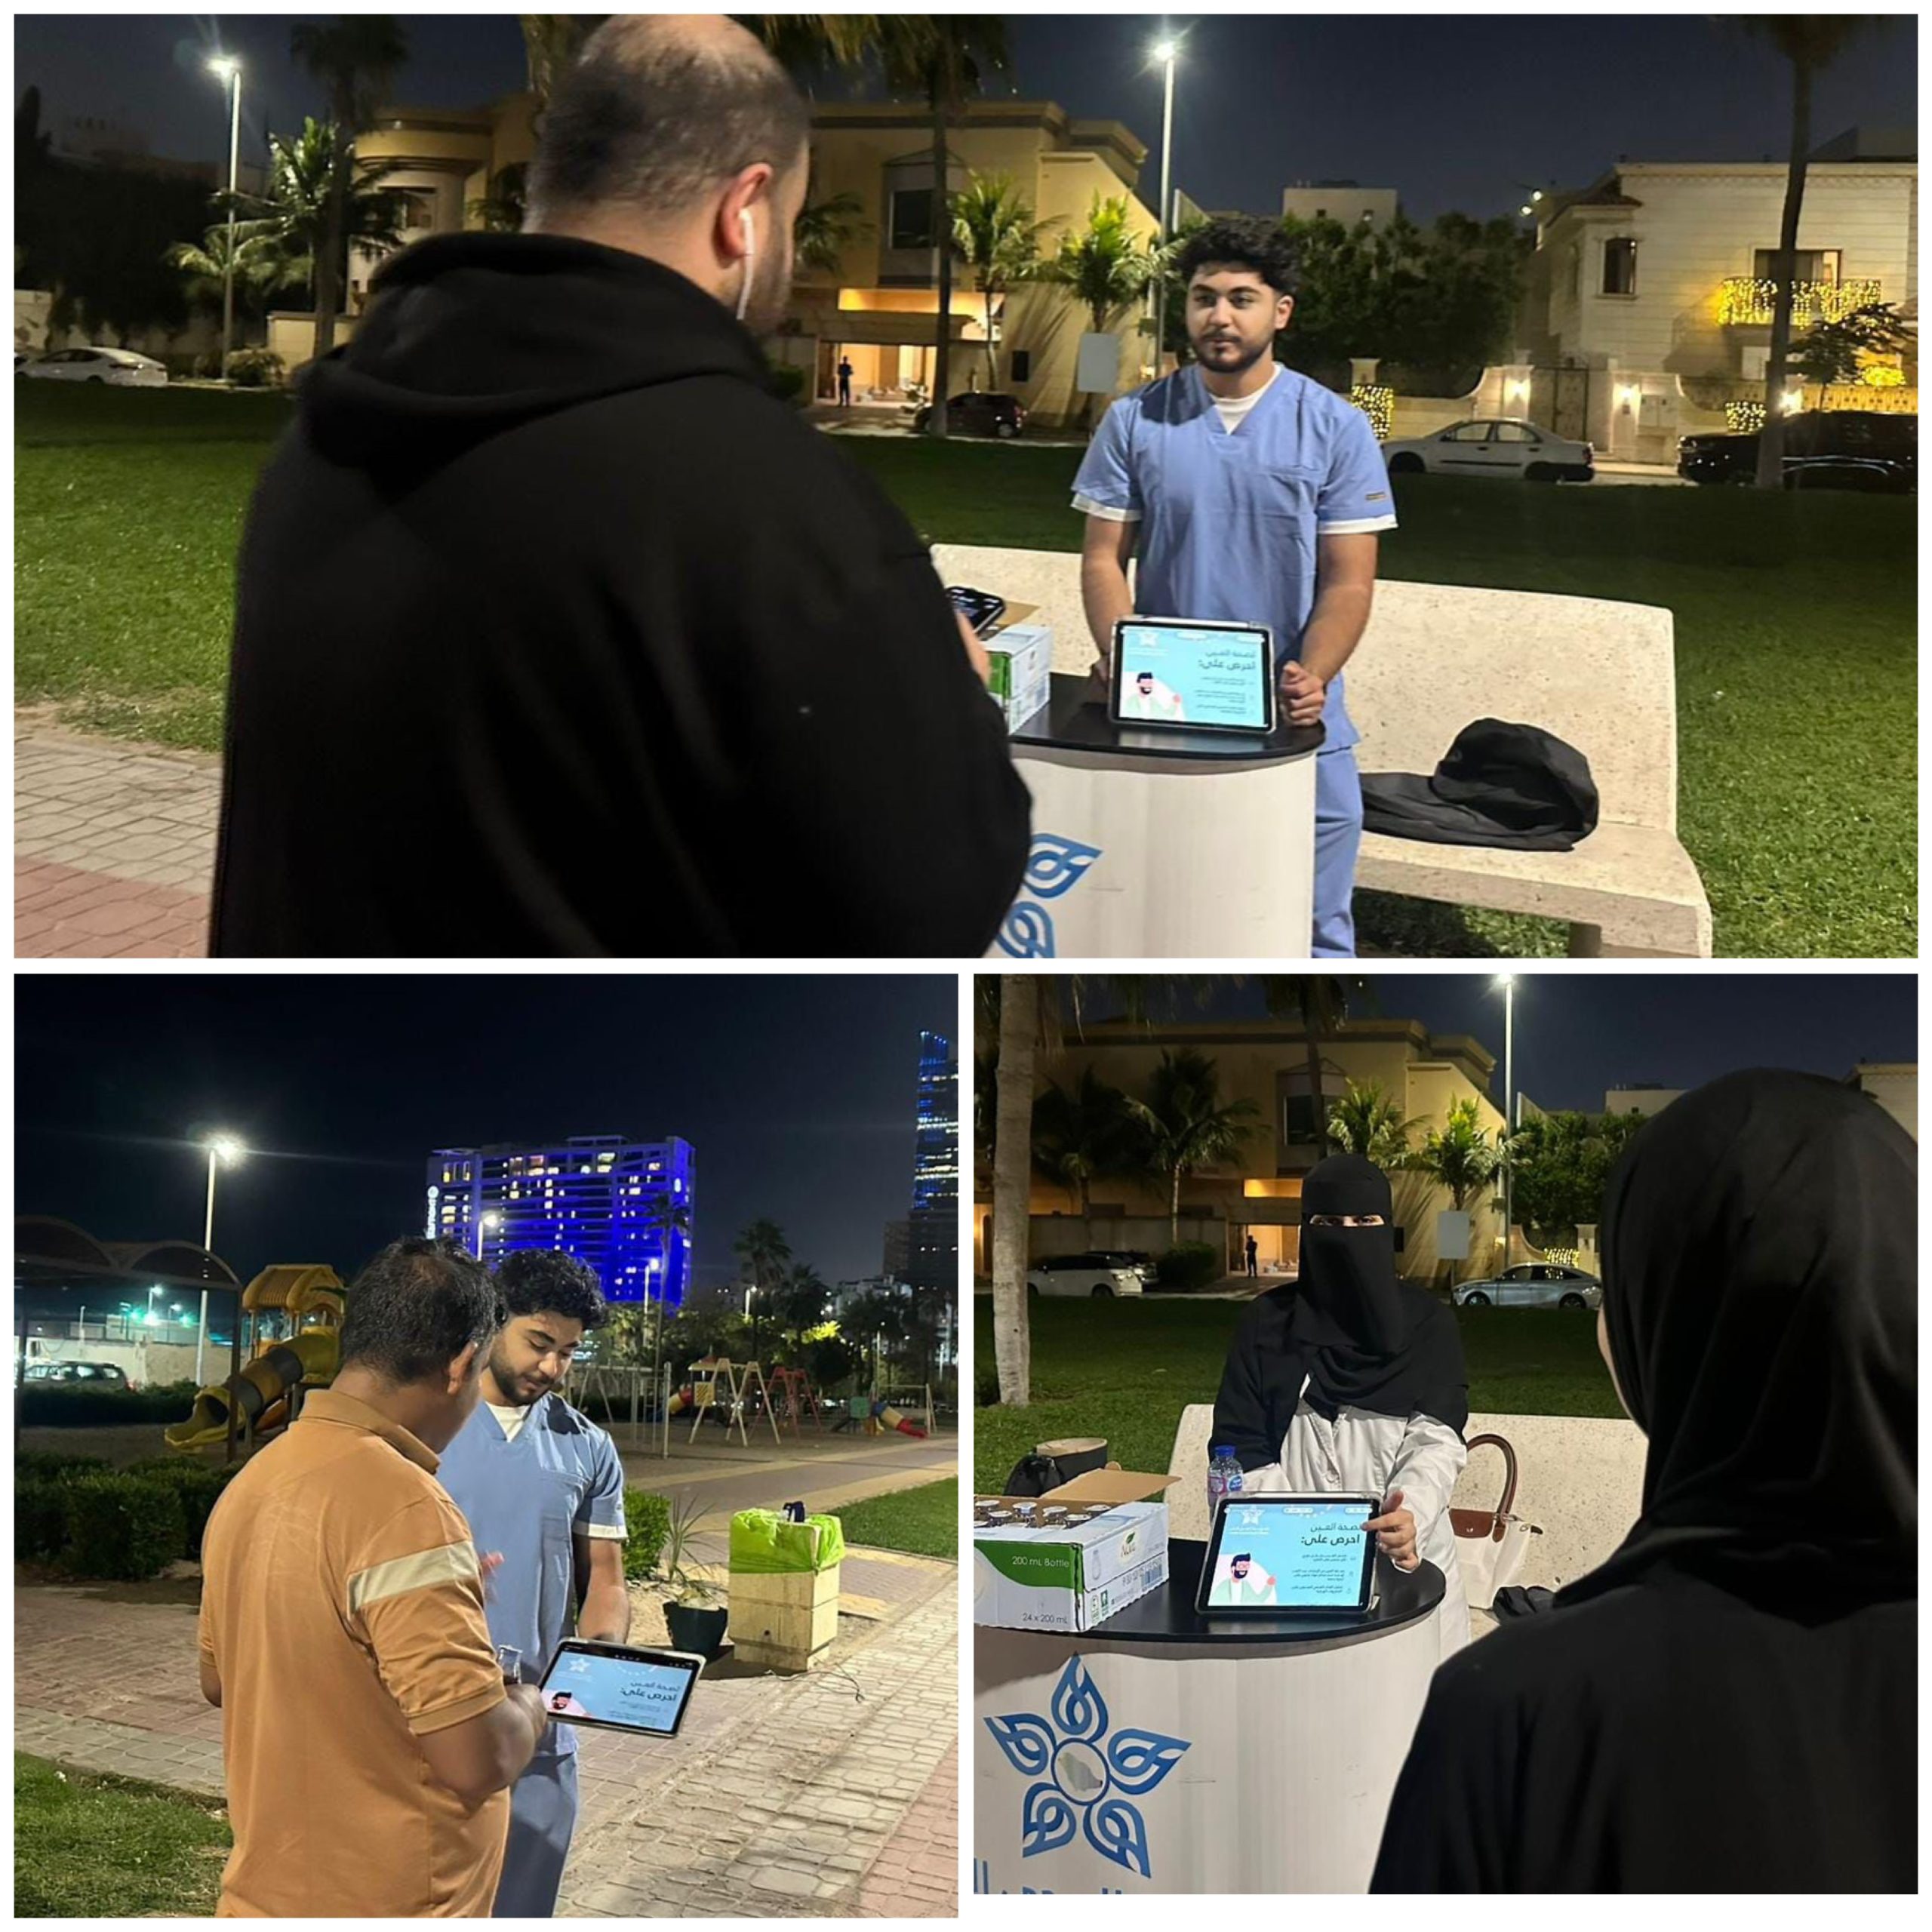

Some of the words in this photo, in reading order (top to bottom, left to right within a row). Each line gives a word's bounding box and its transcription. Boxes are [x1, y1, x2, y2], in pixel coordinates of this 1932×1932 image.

[1330, 1534, 1360, 1546] احرص
[1012, 1555, 1028, 1566] 200
[1029, 1558, 1043, 1567] mL
[1044, 1558, 1069, 1568] Bottle
[1022, 1612, 1032, 1622] 24
[1040, 1614, 1055, 1623] 200
